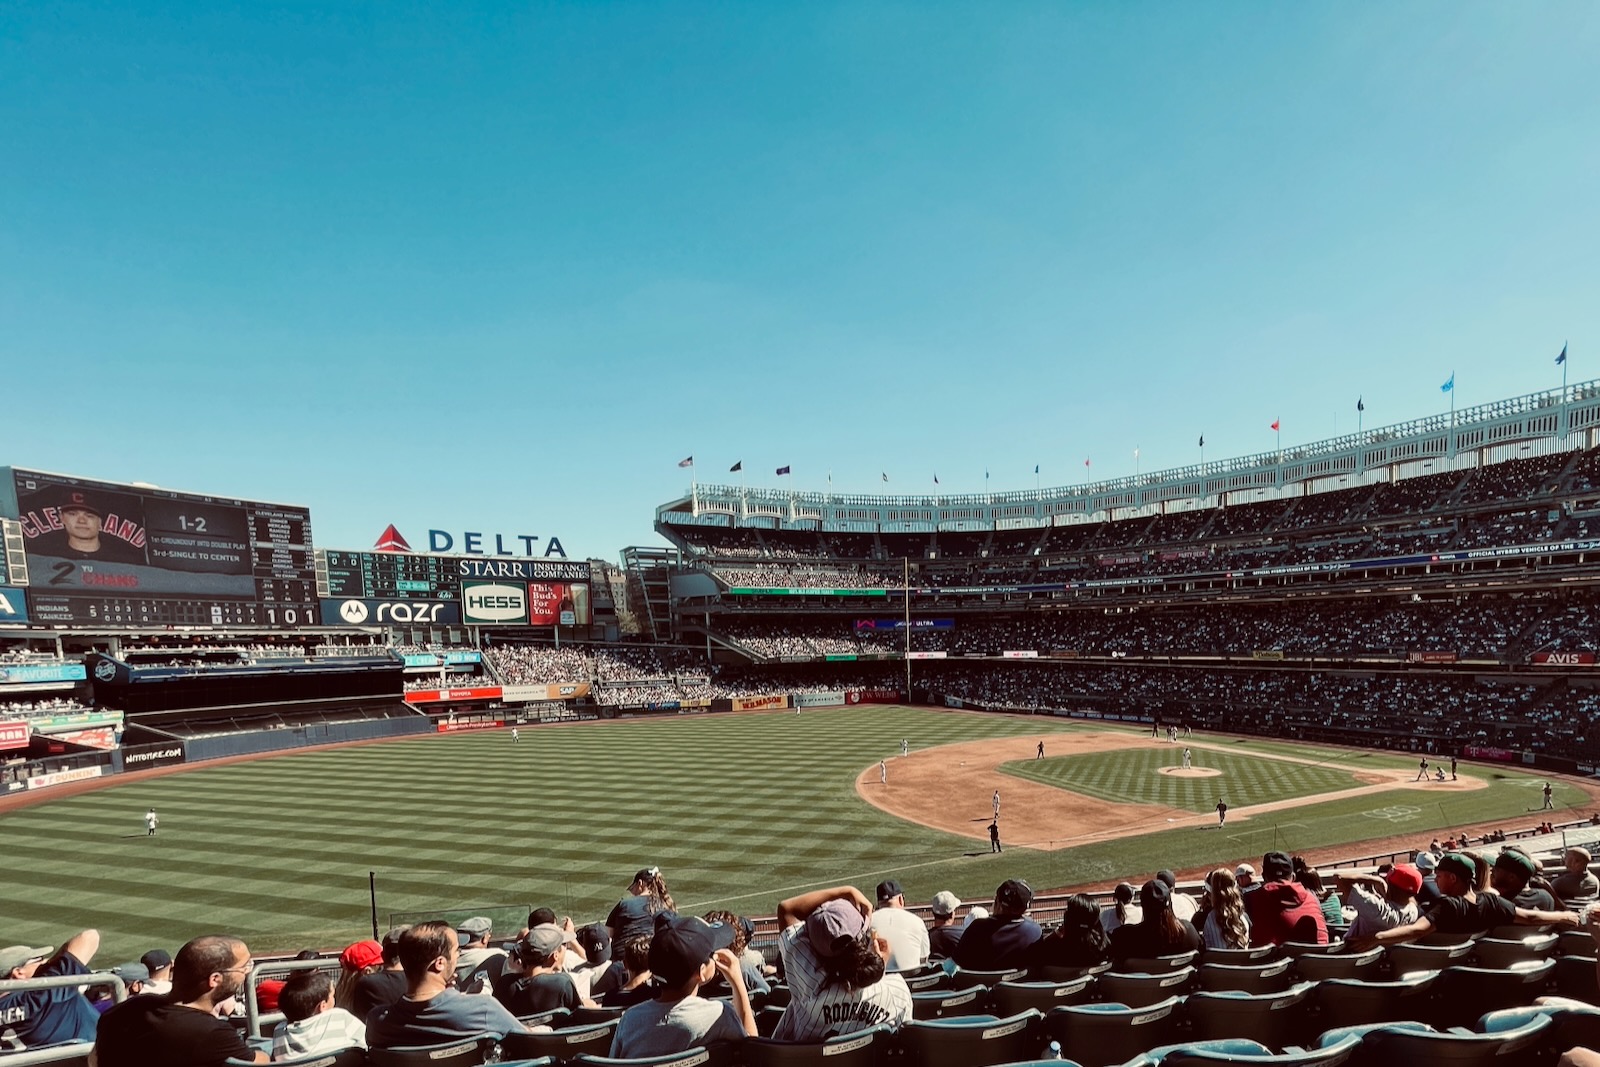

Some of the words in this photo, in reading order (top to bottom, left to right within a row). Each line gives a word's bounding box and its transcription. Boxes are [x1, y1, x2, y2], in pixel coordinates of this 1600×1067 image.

[178, 515, 207, 532] 1-2
[428, 529, 568, 558] DELTA
[210, 554, 240, 562] CENTER
[48, 562, 76, 586] 2
[460, 560, 528, 578] STARR
[534, 563, 590, 571] INSURANCE
[469, 596, 522, 609] HESS
[90, 609, 97, 618] 5
[267, 609, 275, 624] 1
[285, 609, 297, 624] 0
[306, 610, 314, 624] 1
[377, 603, 444, 622] razr
[1546, 654, 1579, 664] AVIS
[126, 748, 182, 764] NITTOTIRE.COM
